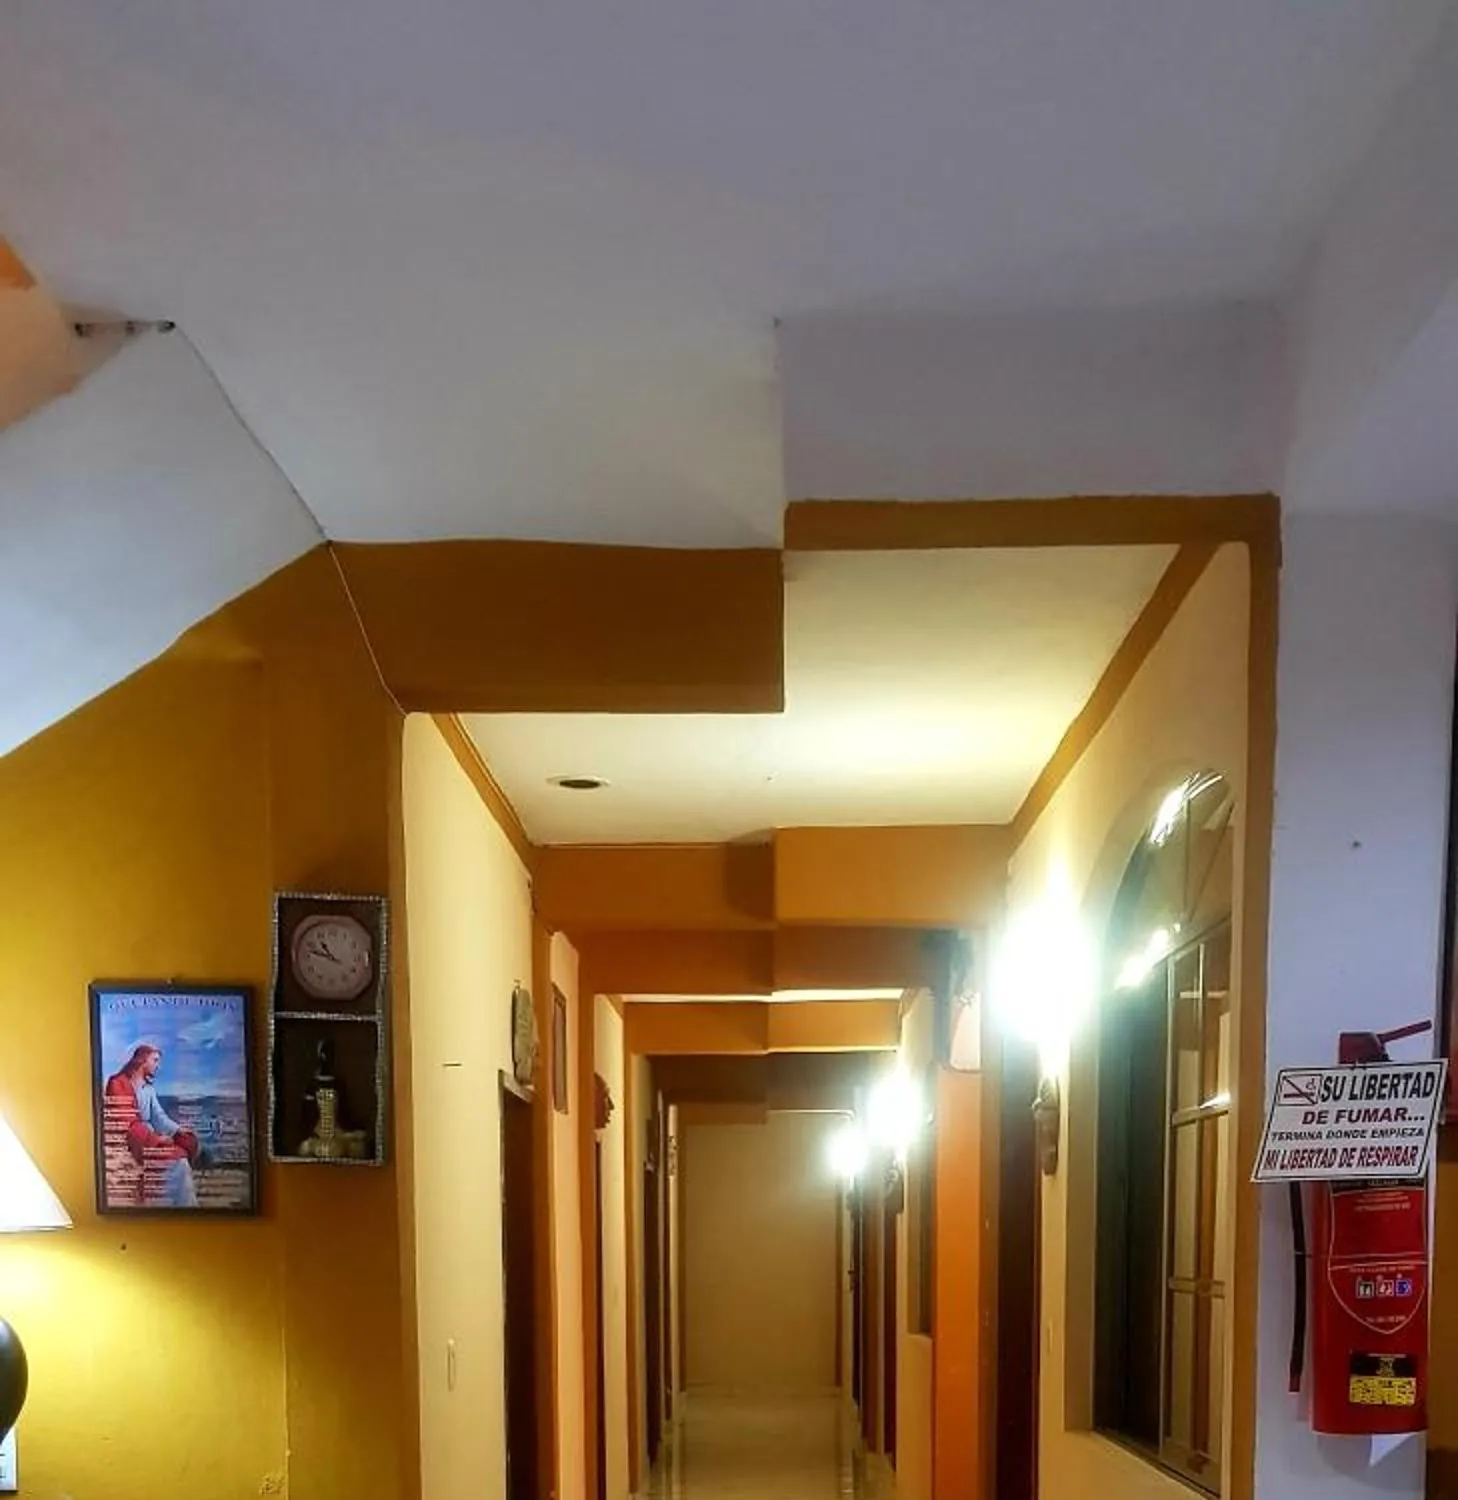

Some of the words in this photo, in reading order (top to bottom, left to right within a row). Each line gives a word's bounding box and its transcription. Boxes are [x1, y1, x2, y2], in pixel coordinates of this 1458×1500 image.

[1321, 1075, 1345, 1101] SU
[1350, 1071, 1435, 1100] LIBERTAD
[1302, 1110, 1330, 1125] DE
[1335, 1107, 1425, 1125] FUMAR...
[1271, 1131, 1323, 1142] TERMINA
[1325, 1129, 1367, 1140] DONDE
[1370, 1127, 1425, 1139] EMPIEZA
[1263, 1150, 1278, 1170] MI
[1279, 1148, 1336, 1170] LIBERTAD
[1337, 1147, 1356, 1168] DE
[1356, 1145, 1418, 1168] RESPIRAR
